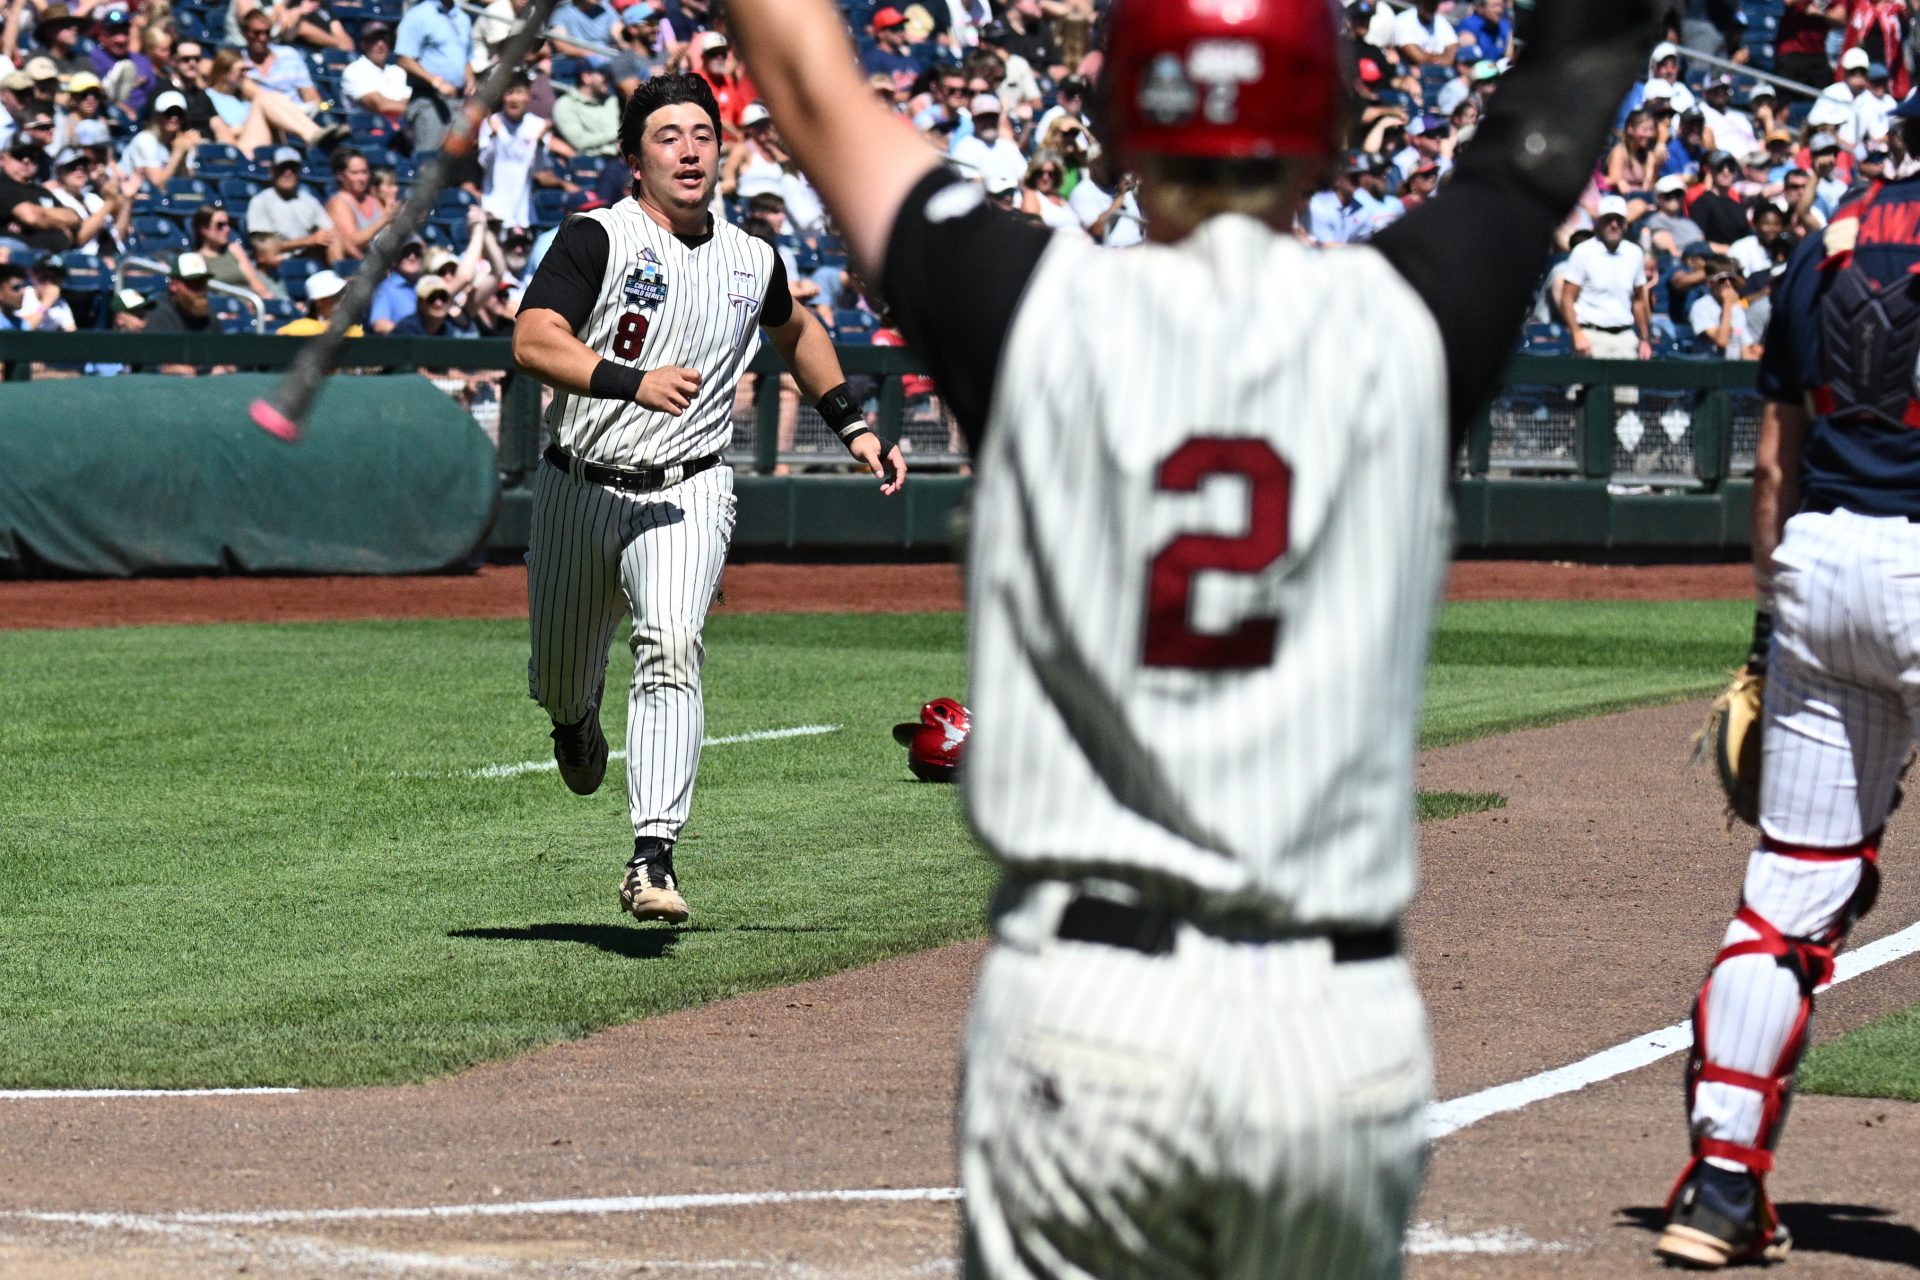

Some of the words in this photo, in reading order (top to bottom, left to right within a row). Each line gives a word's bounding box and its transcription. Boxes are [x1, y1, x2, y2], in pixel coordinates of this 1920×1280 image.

[624, 286, 645, 296] WORLD
[644, 291, 665, 301] SERIES
[633, 282, 658, 293] COLLEGE
[612, 312, 649, 362] 8
[1138, 436, 1293, 669] 2
